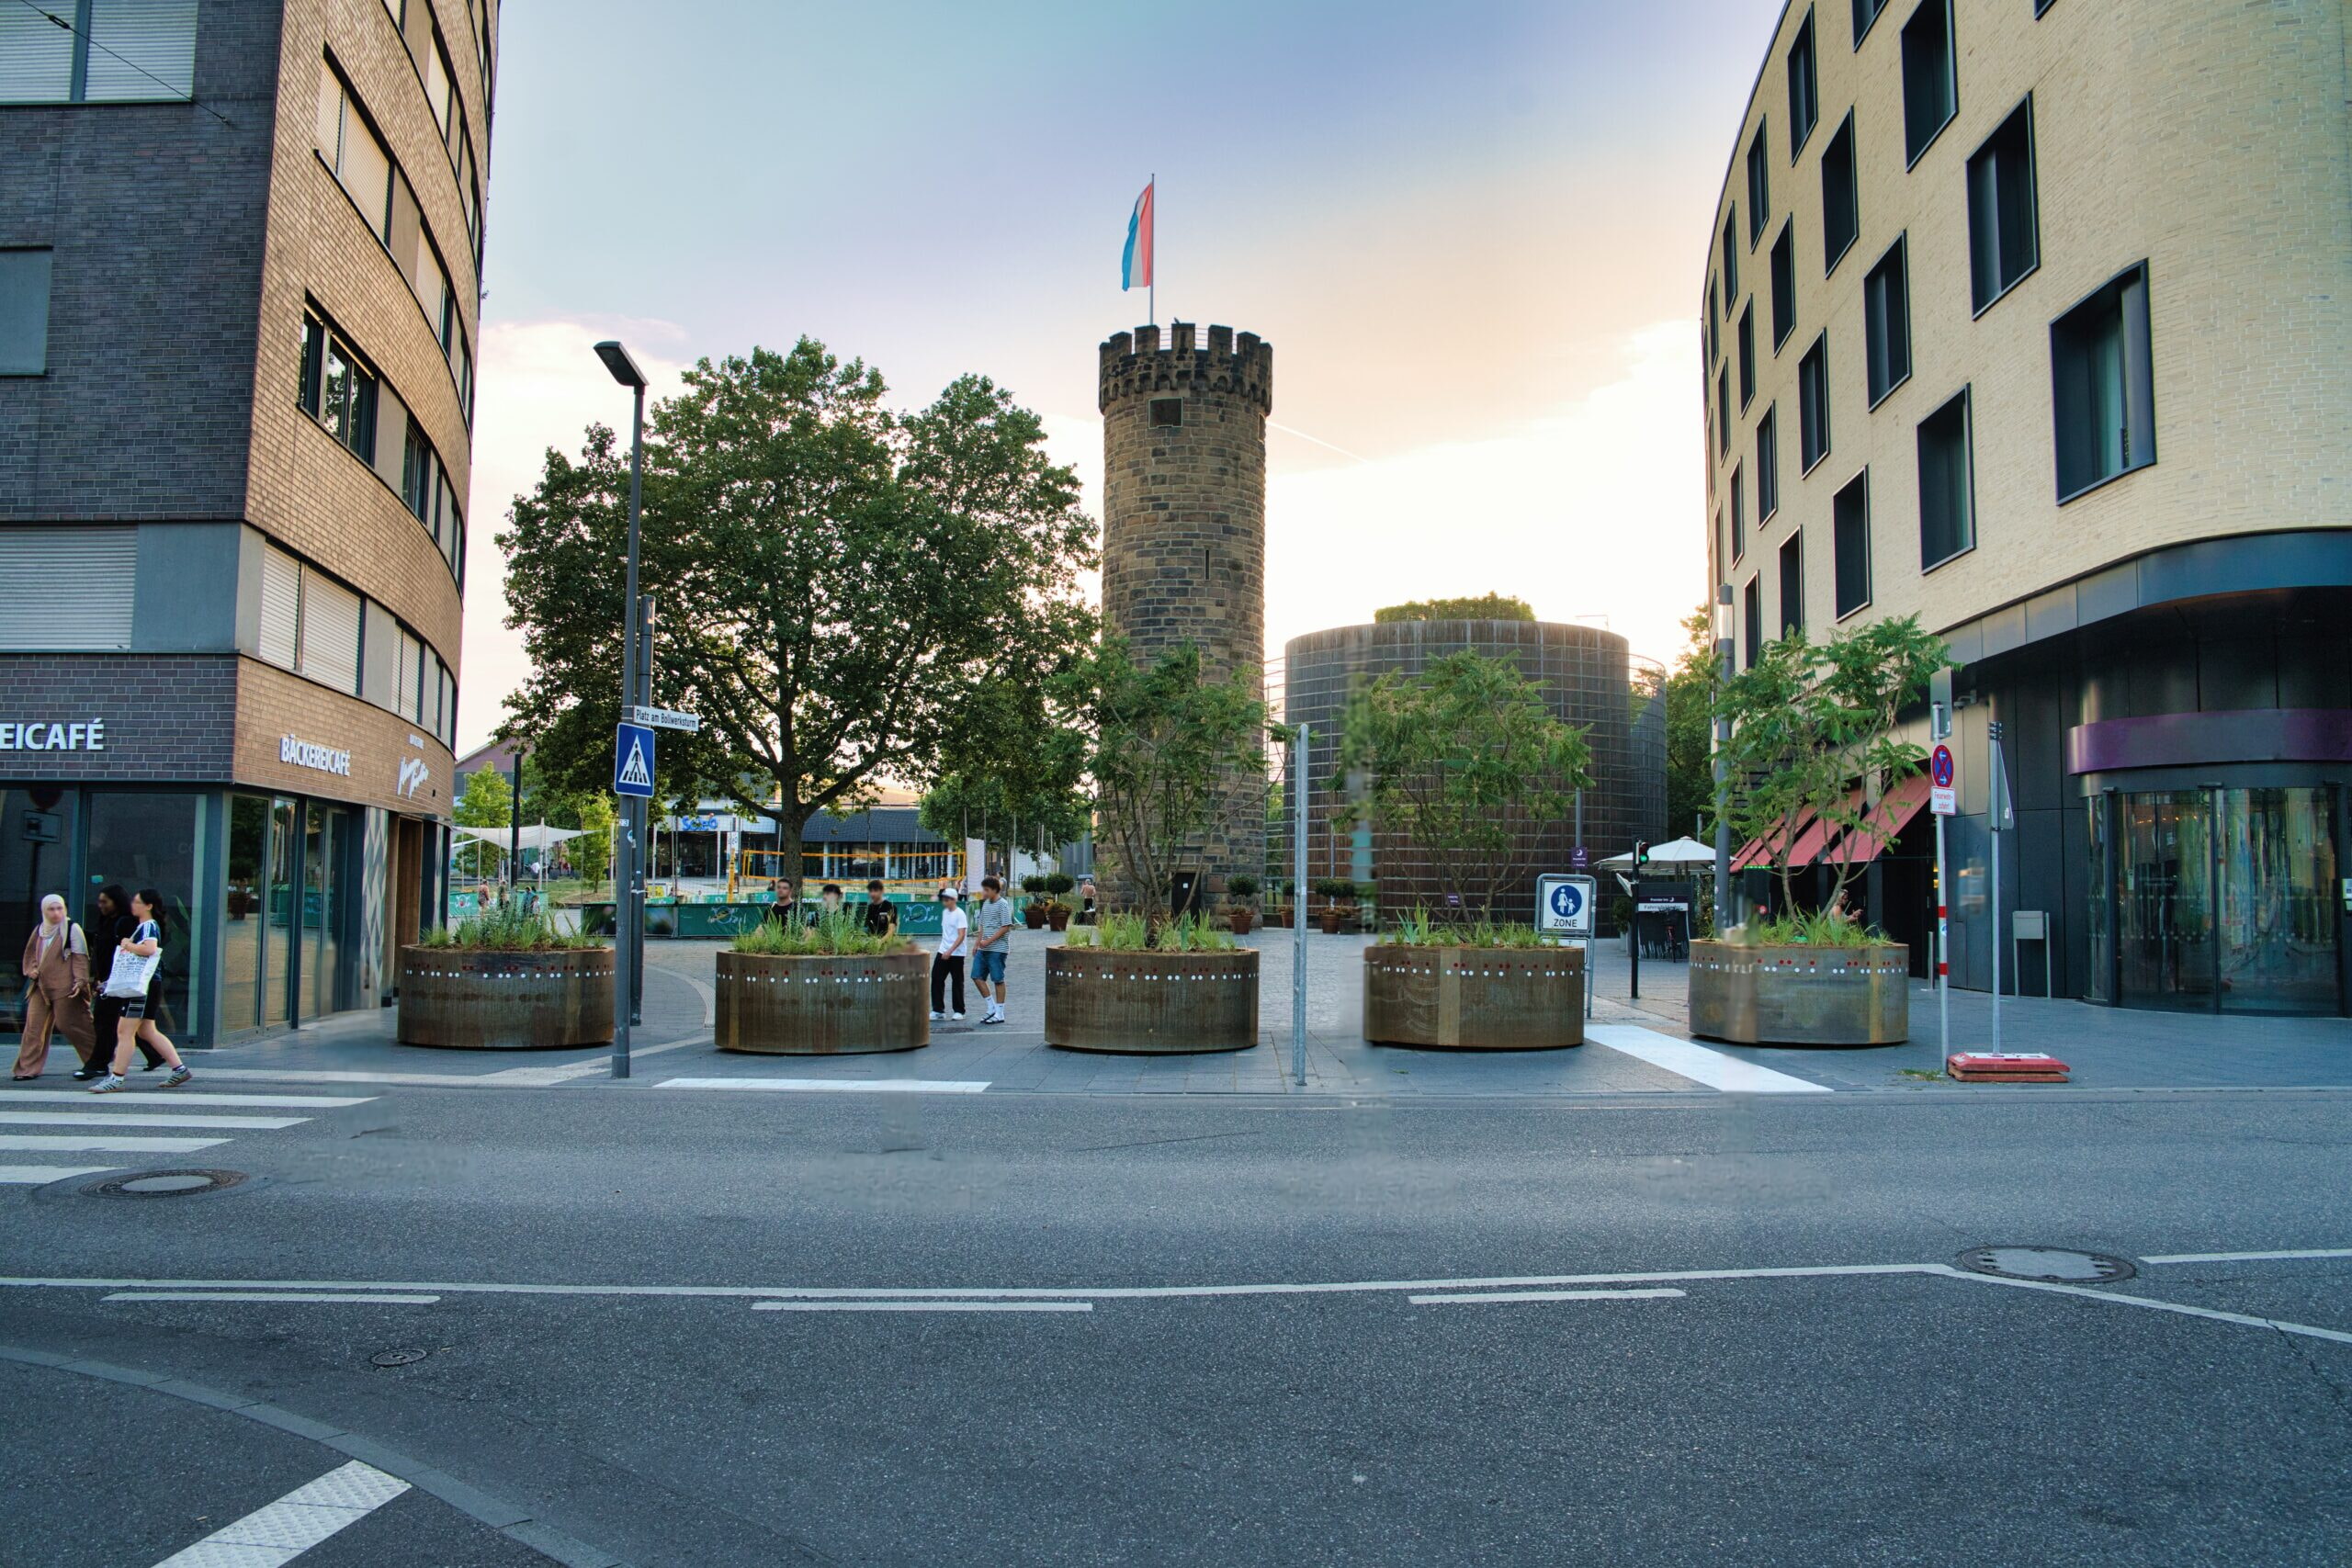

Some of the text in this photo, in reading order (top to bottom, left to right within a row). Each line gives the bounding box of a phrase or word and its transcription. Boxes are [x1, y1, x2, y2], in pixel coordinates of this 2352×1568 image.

[636, 709, 696, 728] Platz am Bollwerksturm
[279, 733, 351, 776] BÄCKEREICAFÉ
[1554, 919, 1577, 928] ZONE
